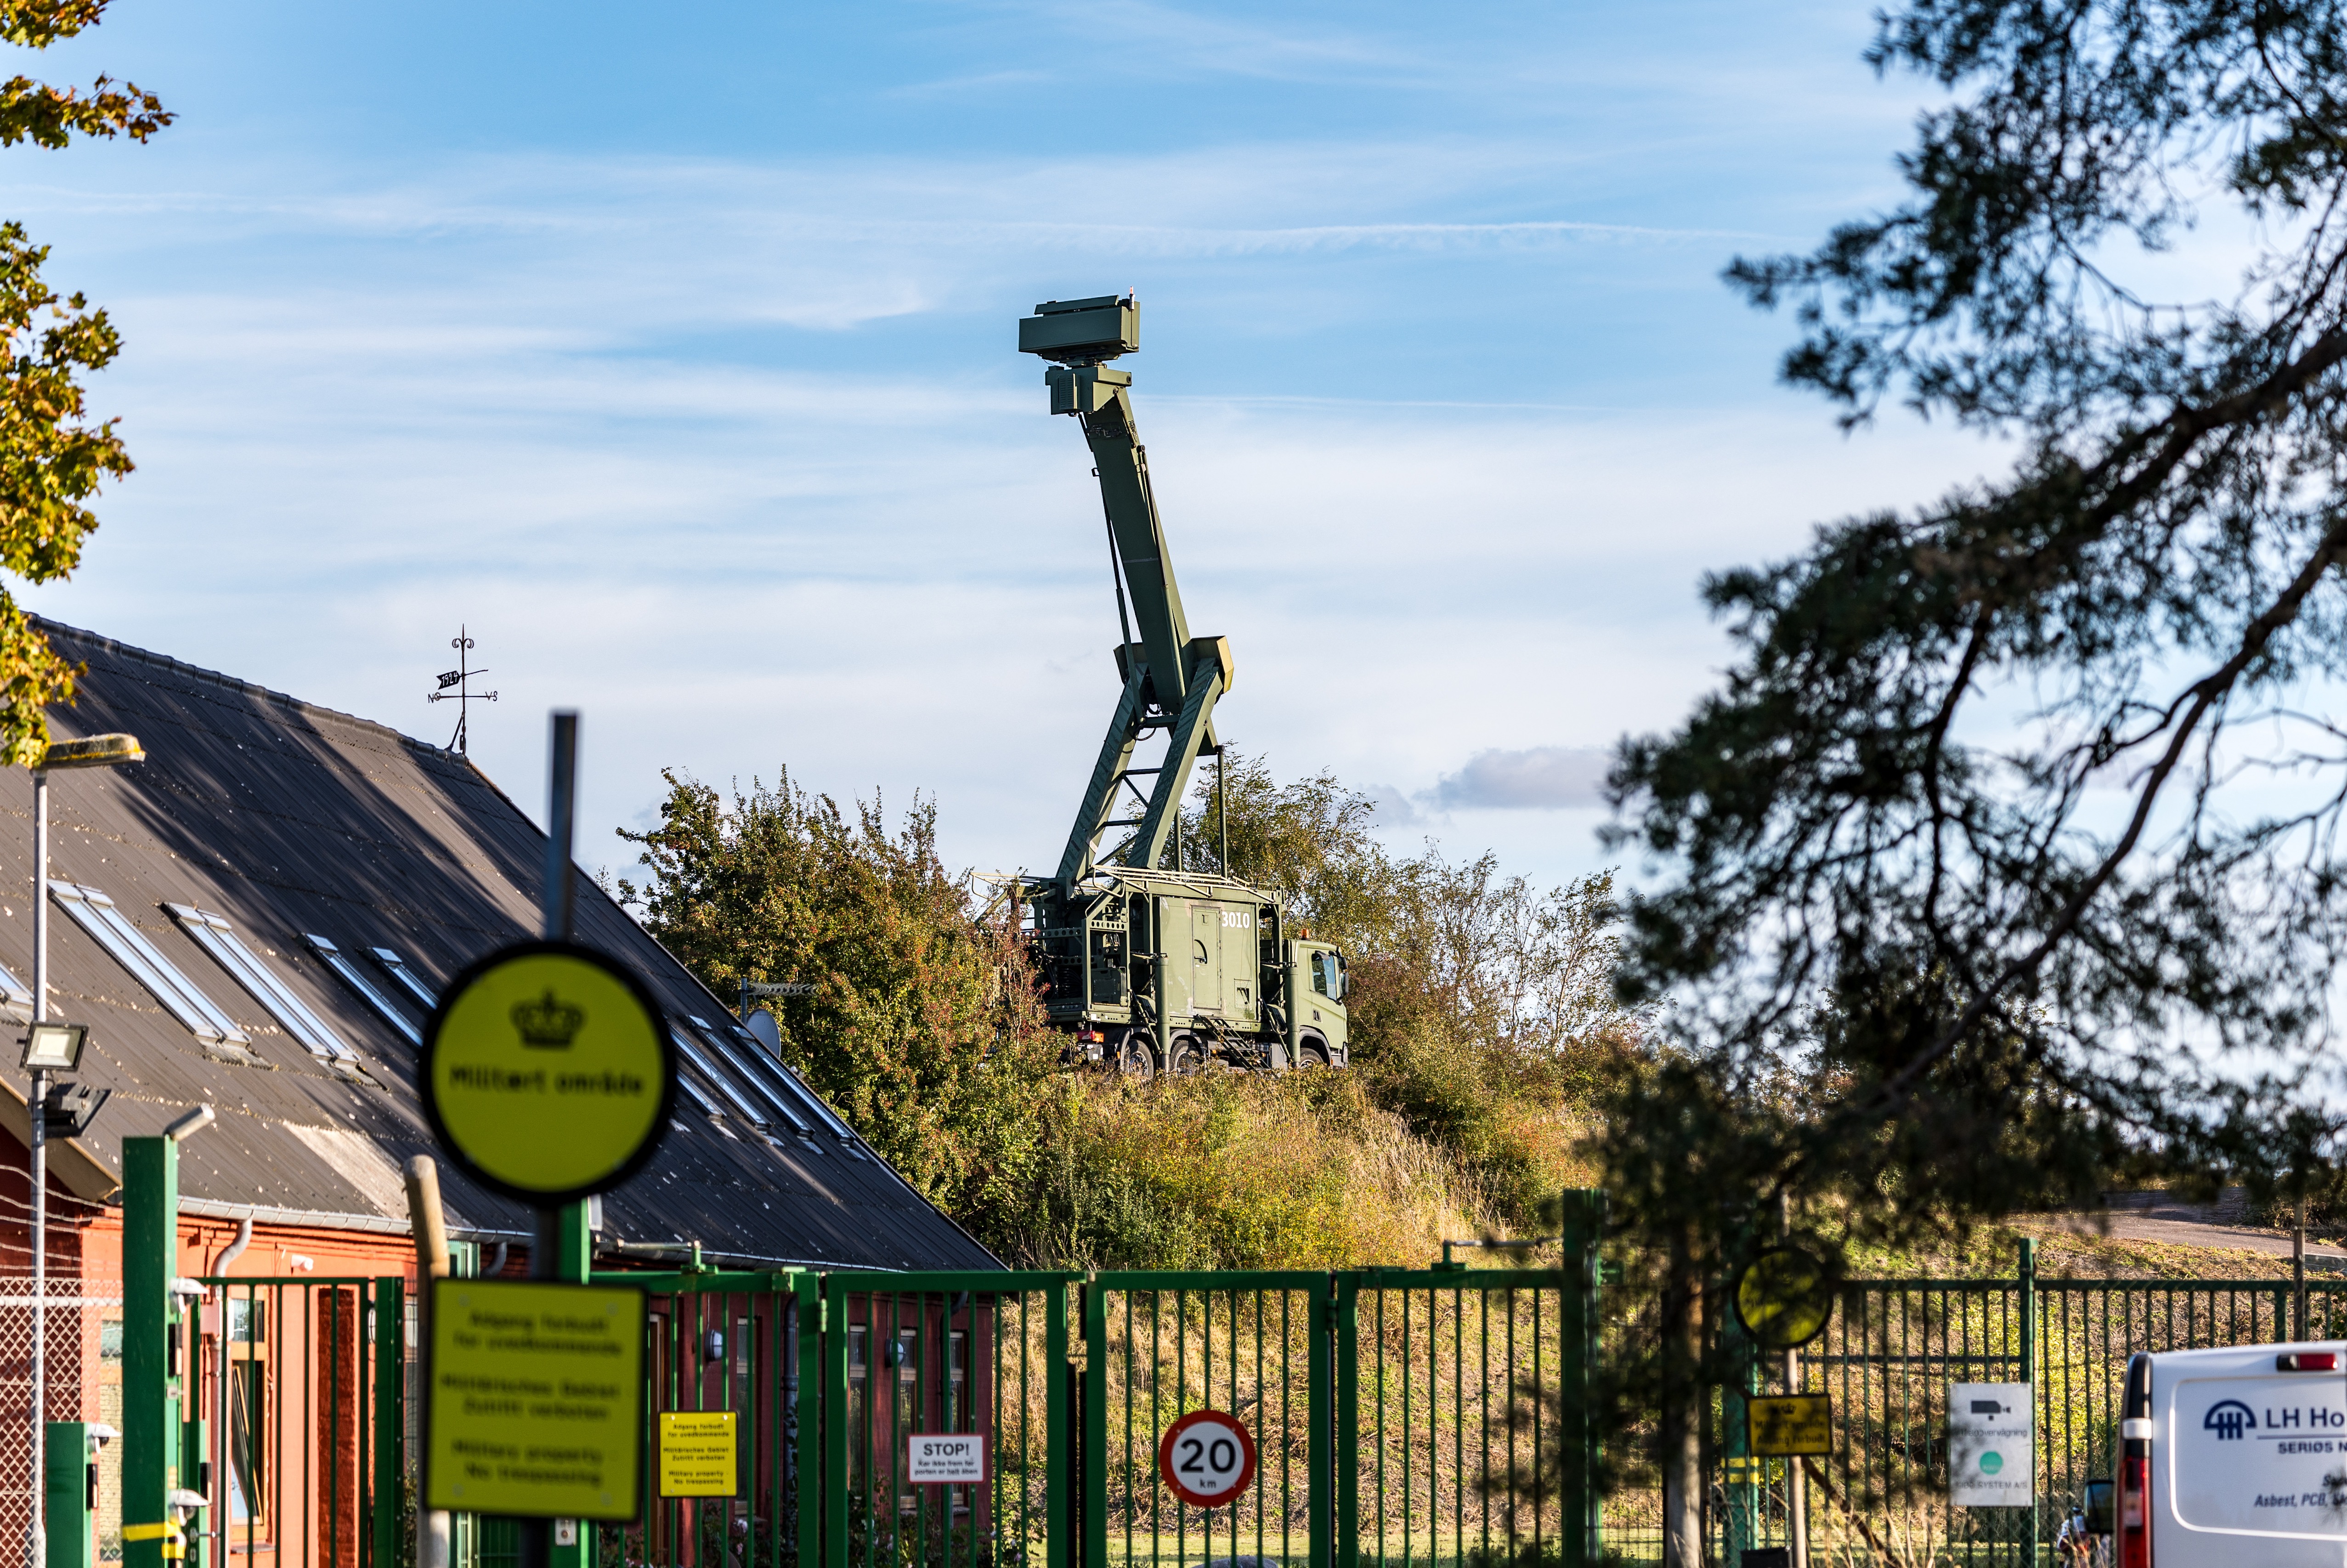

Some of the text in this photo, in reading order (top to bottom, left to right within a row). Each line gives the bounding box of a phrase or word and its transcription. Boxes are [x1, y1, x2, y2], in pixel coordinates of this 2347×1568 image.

[441, 672, 458, 686] 1924
[1222, 911, 1250, 928] 3010
[2266, 1408, 2300, 1428] LH
[923, 1443, 969, 1456] STOP!
[2278, 1441, 2333, 1454] SERIØS
[1181, 1438, 1236, 1474] 20
[1199, 1478, 1217, 1489] km
[1977, 1480, 2012, 1489] SYSTEM
[2014, 1481, 2028, 1489] A/S
[2254, 1494, 2297, 1509] Asbest,
[2301, 1493, 2328, 1508] PCB,
